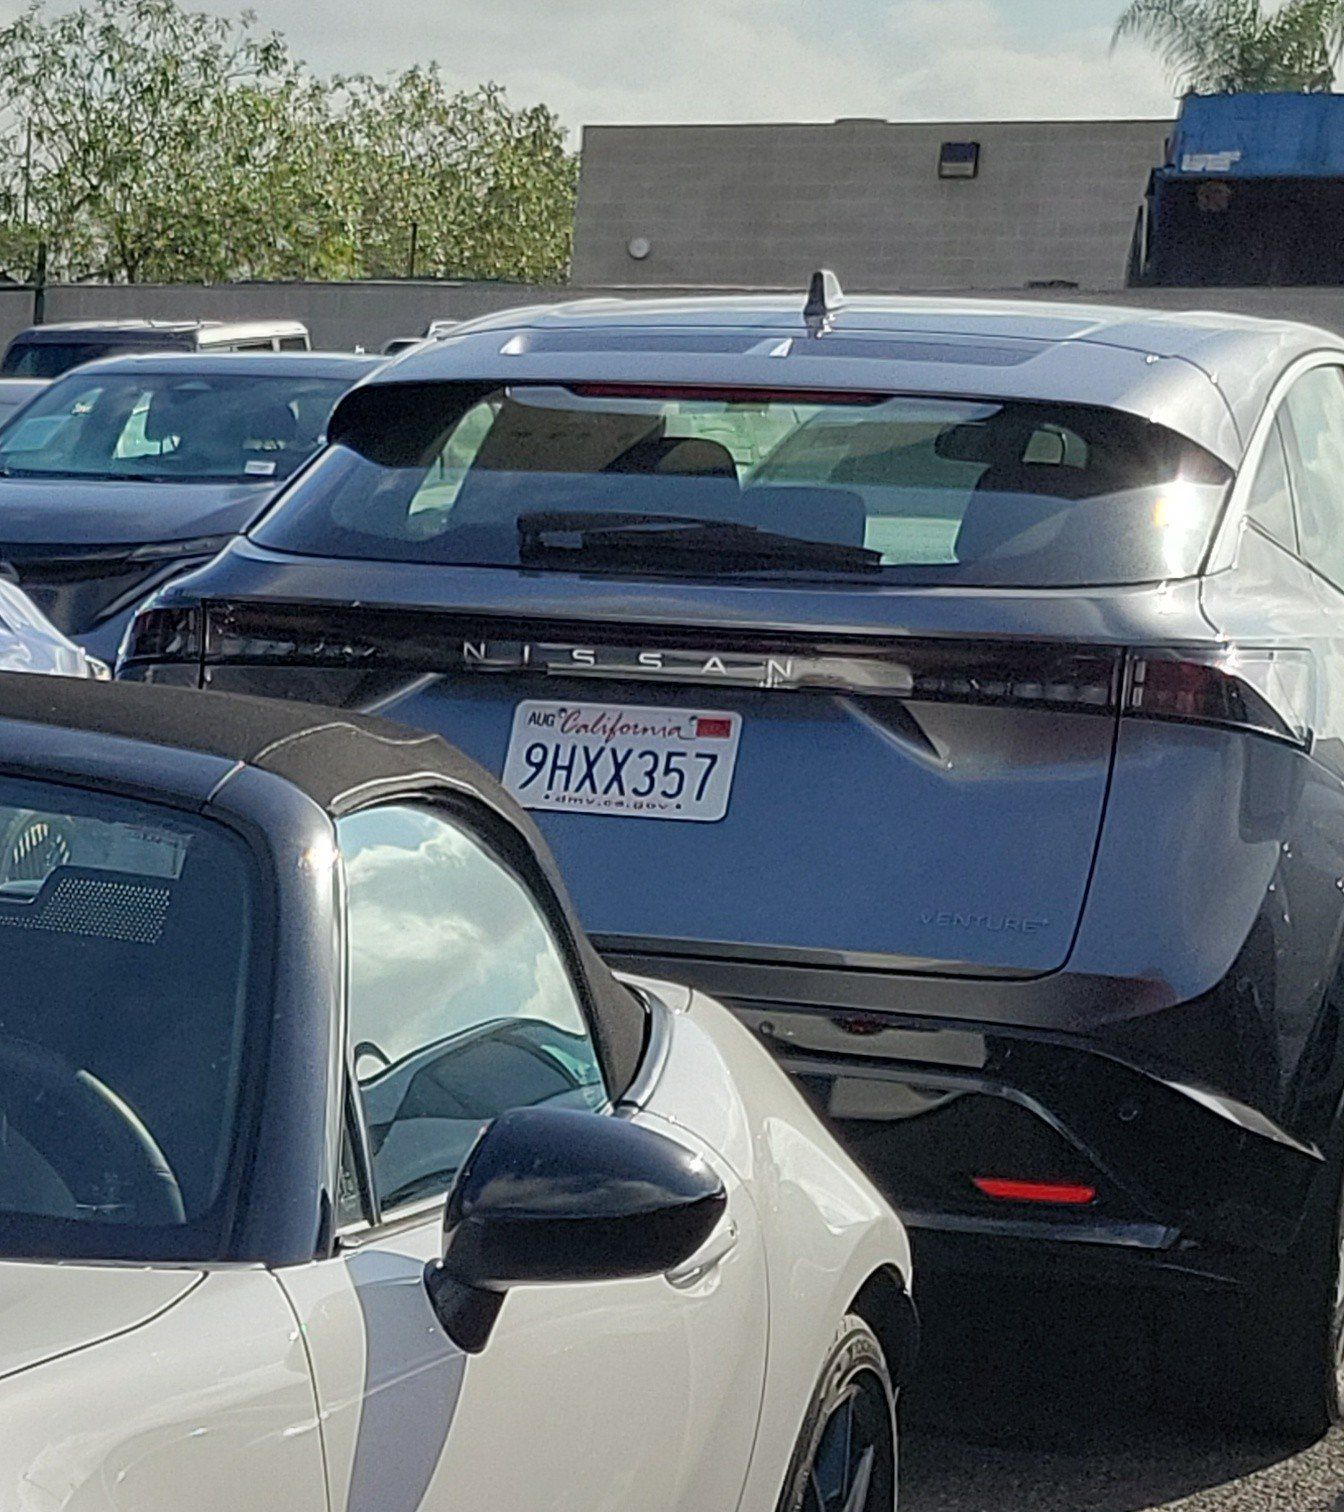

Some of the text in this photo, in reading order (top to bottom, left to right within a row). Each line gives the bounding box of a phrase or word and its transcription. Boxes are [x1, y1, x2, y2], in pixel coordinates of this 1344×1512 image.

[463, 641, 792, 679] NISSAN
[527, 711, 555, 727] AUG
[560, 708, 696, 744] California
[518, 742, 718, 802] 9HXX357
